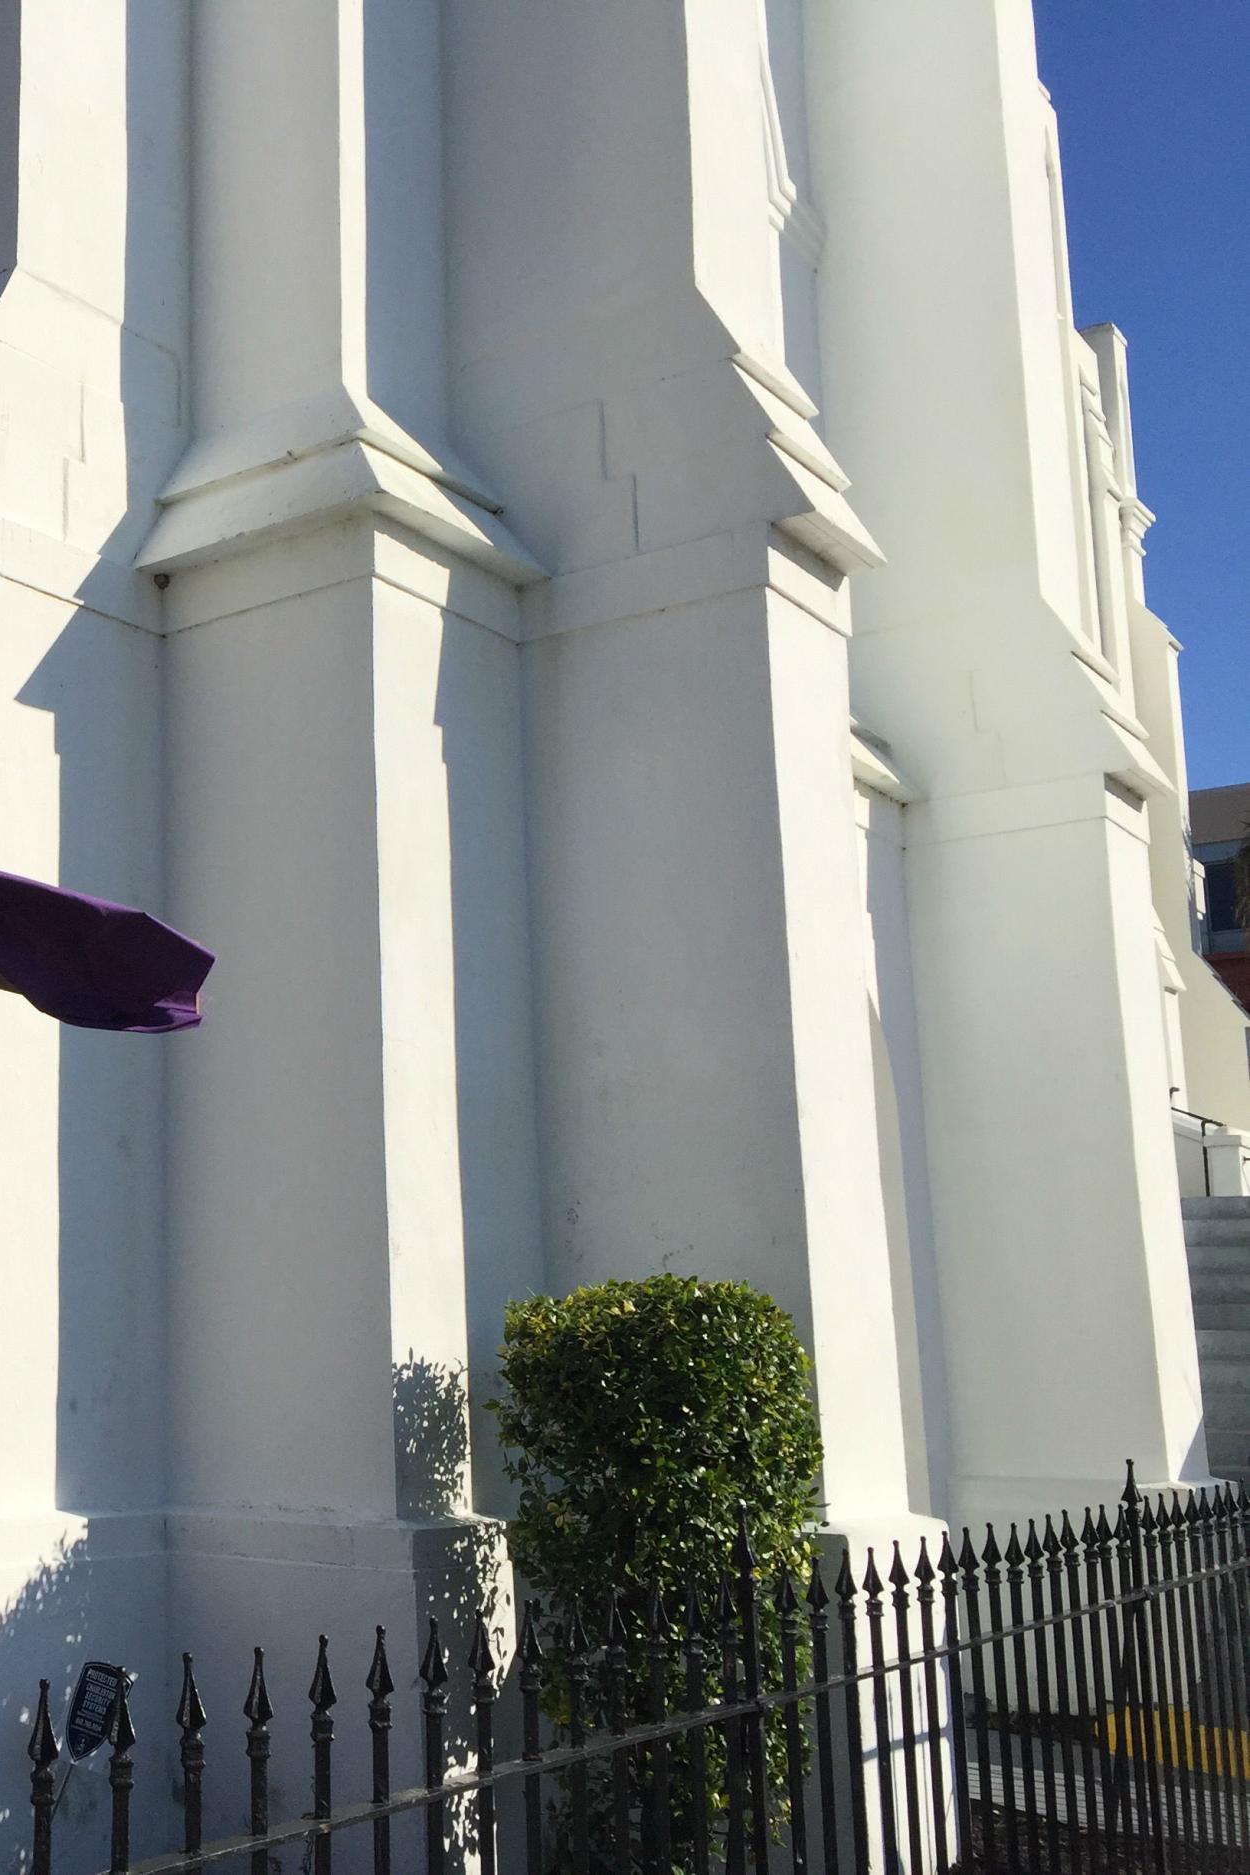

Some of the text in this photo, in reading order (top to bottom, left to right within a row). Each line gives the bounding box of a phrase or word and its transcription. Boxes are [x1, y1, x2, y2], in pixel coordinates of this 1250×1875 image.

[86, 1668, 119, 1687] PROTECTED
[84, 1691, 111, 1707] SECURITY
[81, 1700, 107, 1715] SYSTEMS
